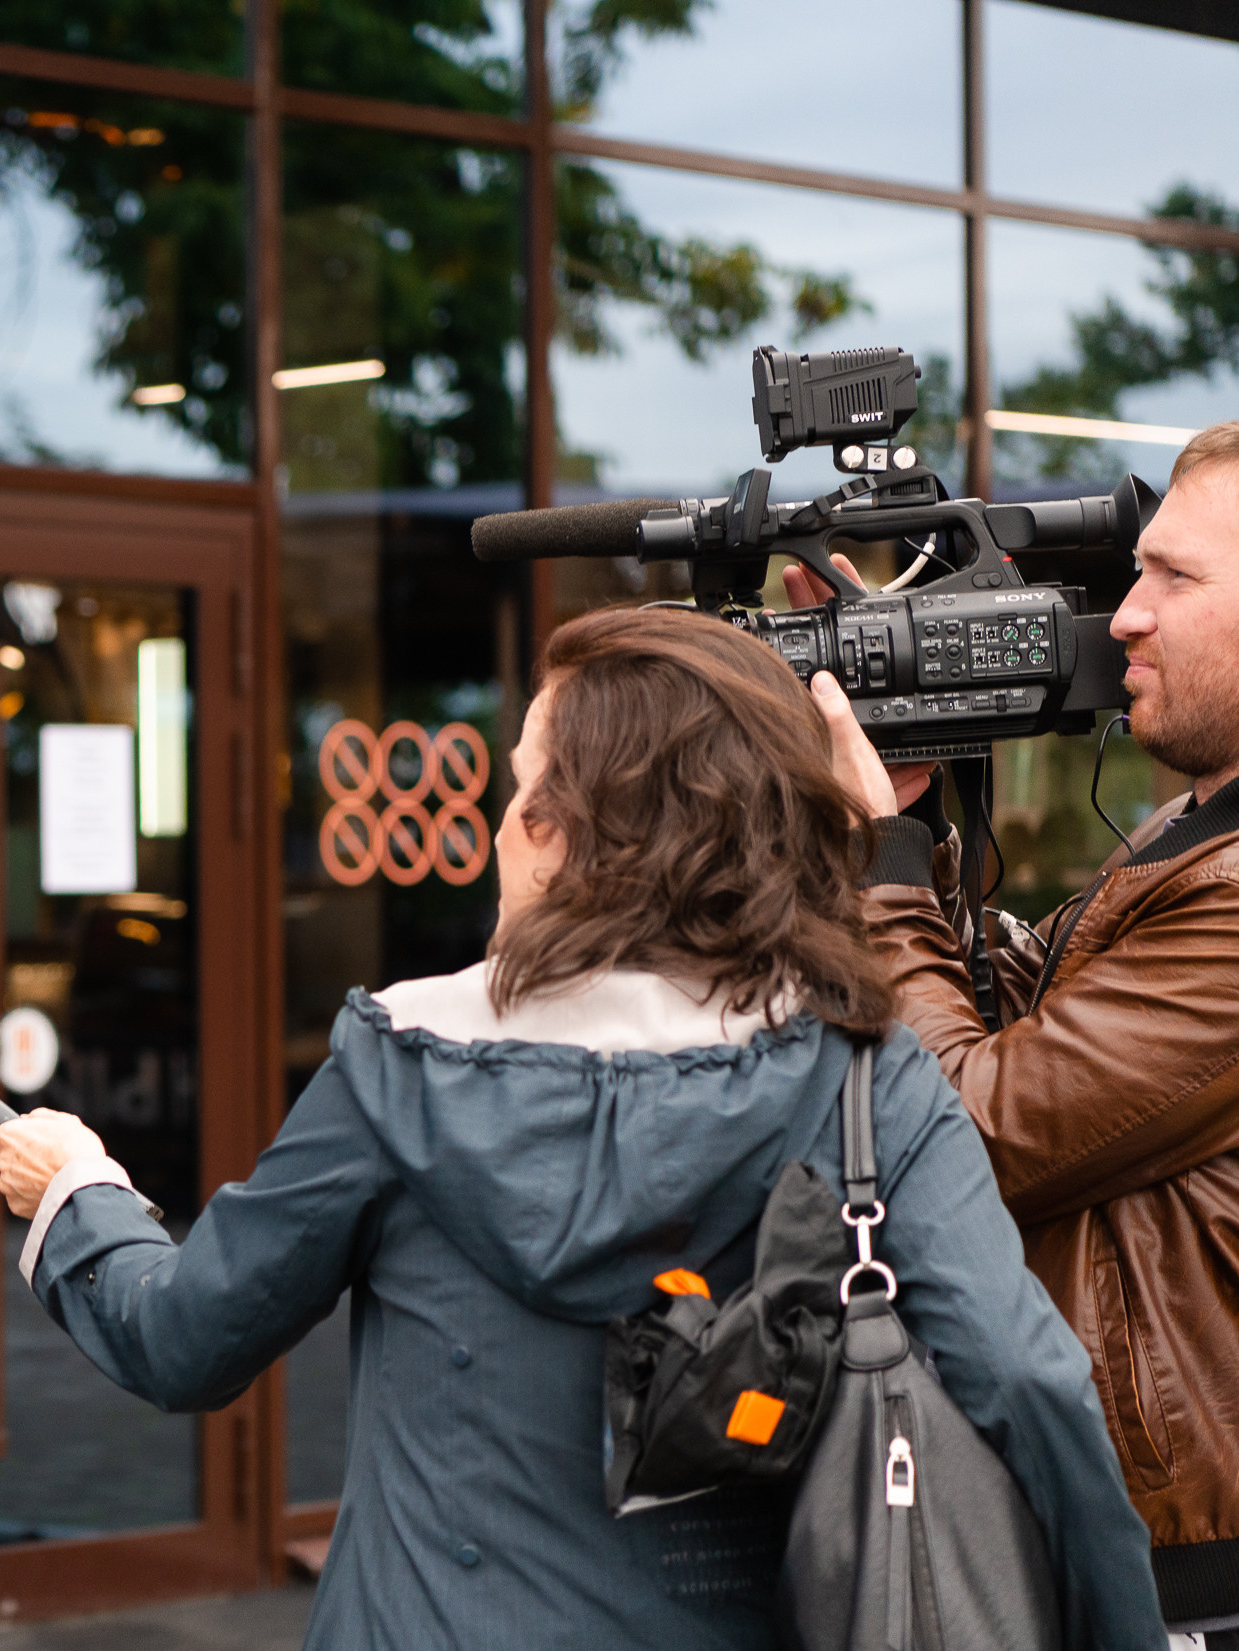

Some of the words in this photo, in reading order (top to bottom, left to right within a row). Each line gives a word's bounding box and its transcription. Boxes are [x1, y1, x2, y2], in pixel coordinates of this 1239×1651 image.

[851, 411, 884, 423] SWIT
[873, 453, 881, 463] 2
[995, 592, 1046, 603] SONY
[842, 604, 869, 612] 4K
